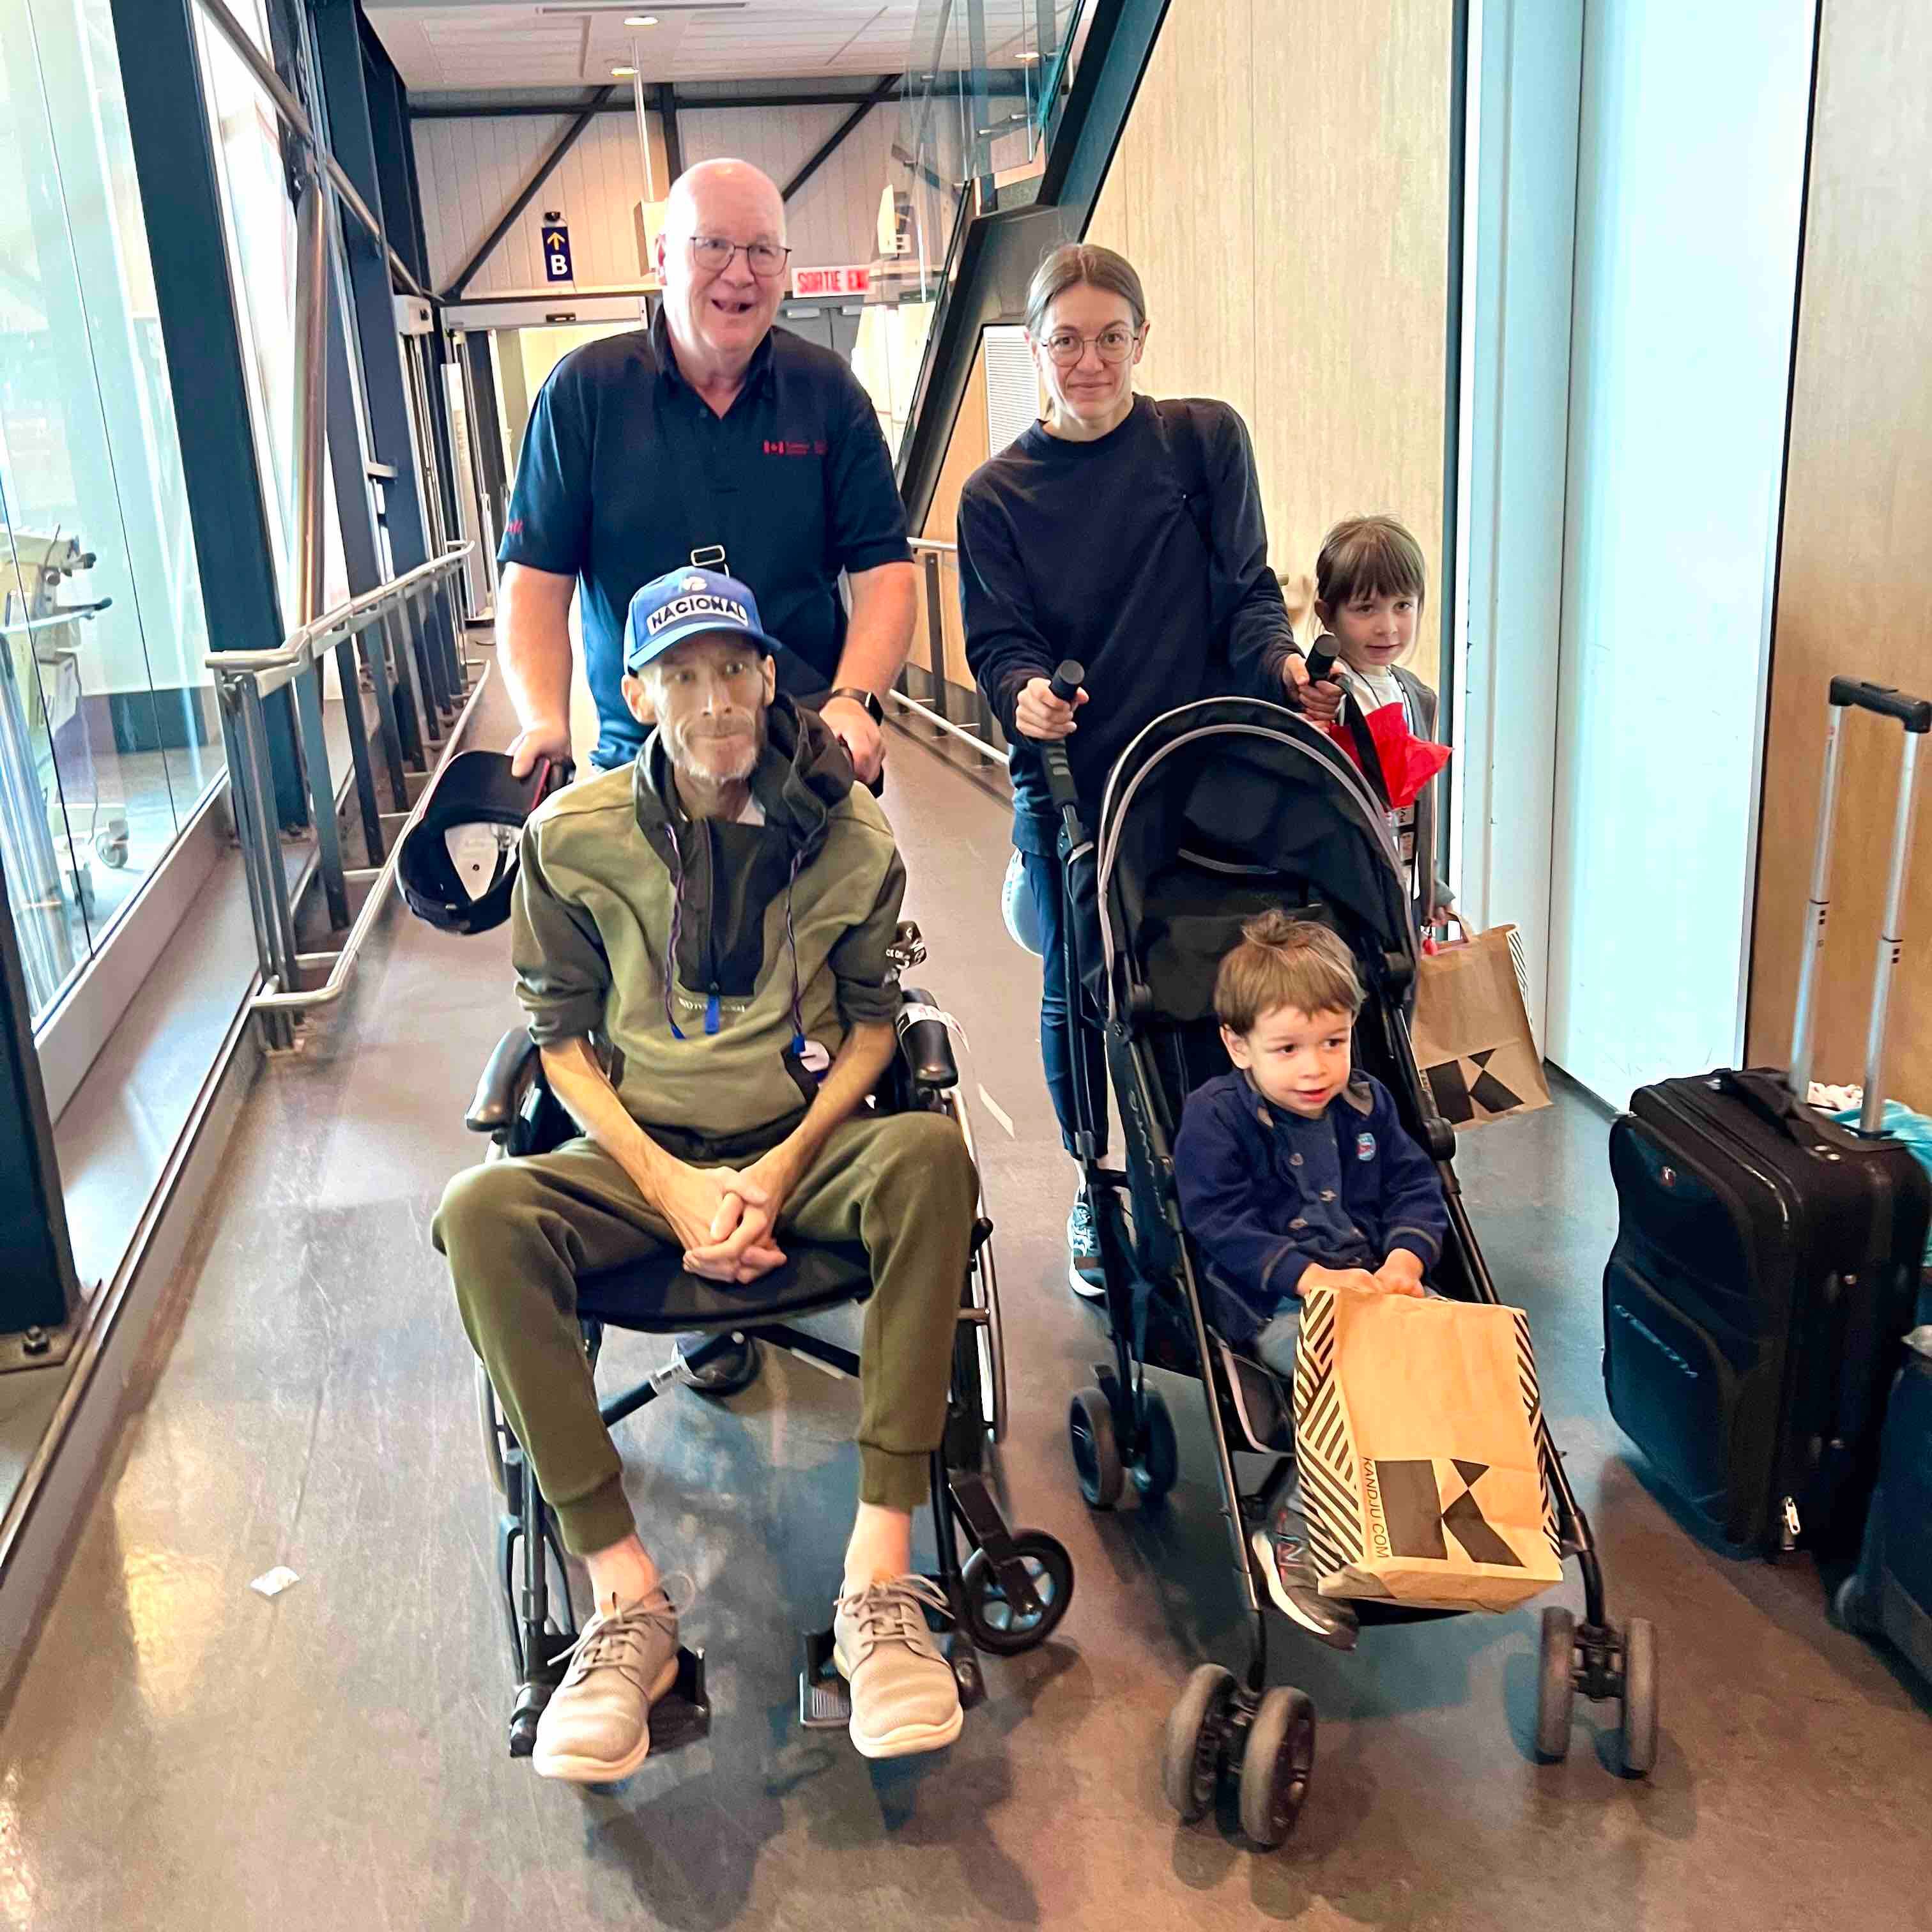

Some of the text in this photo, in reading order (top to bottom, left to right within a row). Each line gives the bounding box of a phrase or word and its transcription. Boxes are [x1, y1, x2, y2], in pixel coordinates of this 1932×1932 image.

[551, 254, 568, 275] B
[798, 271, 842, 294] SORTIE
[652, 597, 746, 629] NACIONAL
